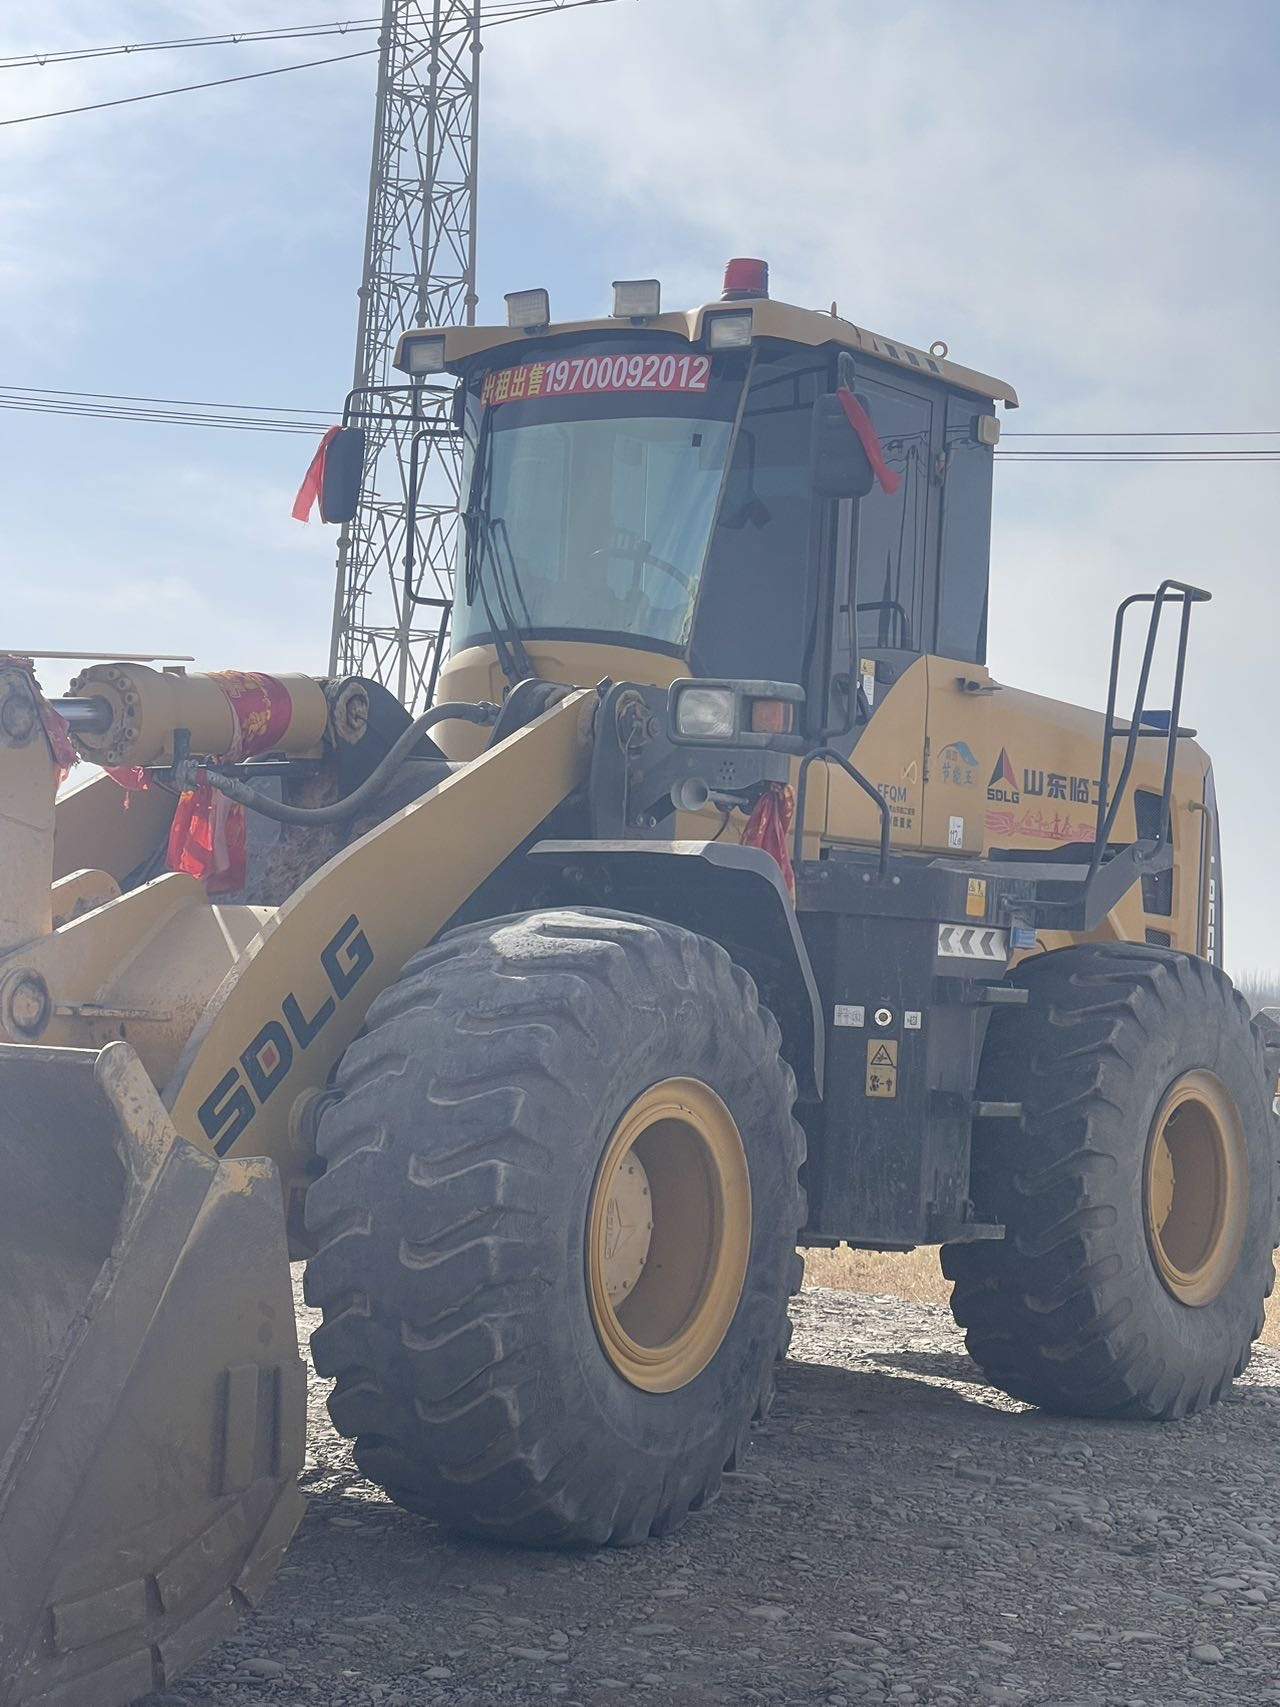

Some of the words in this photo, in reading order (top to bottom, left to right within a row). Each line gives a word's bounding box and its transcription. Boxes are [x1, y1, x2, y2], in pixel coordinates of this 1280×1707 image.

[546, 355, 710, 393] 19700092012
[987, 788, 1020, 804] SDLG
[197, 913, 375, 1158] SDLG
